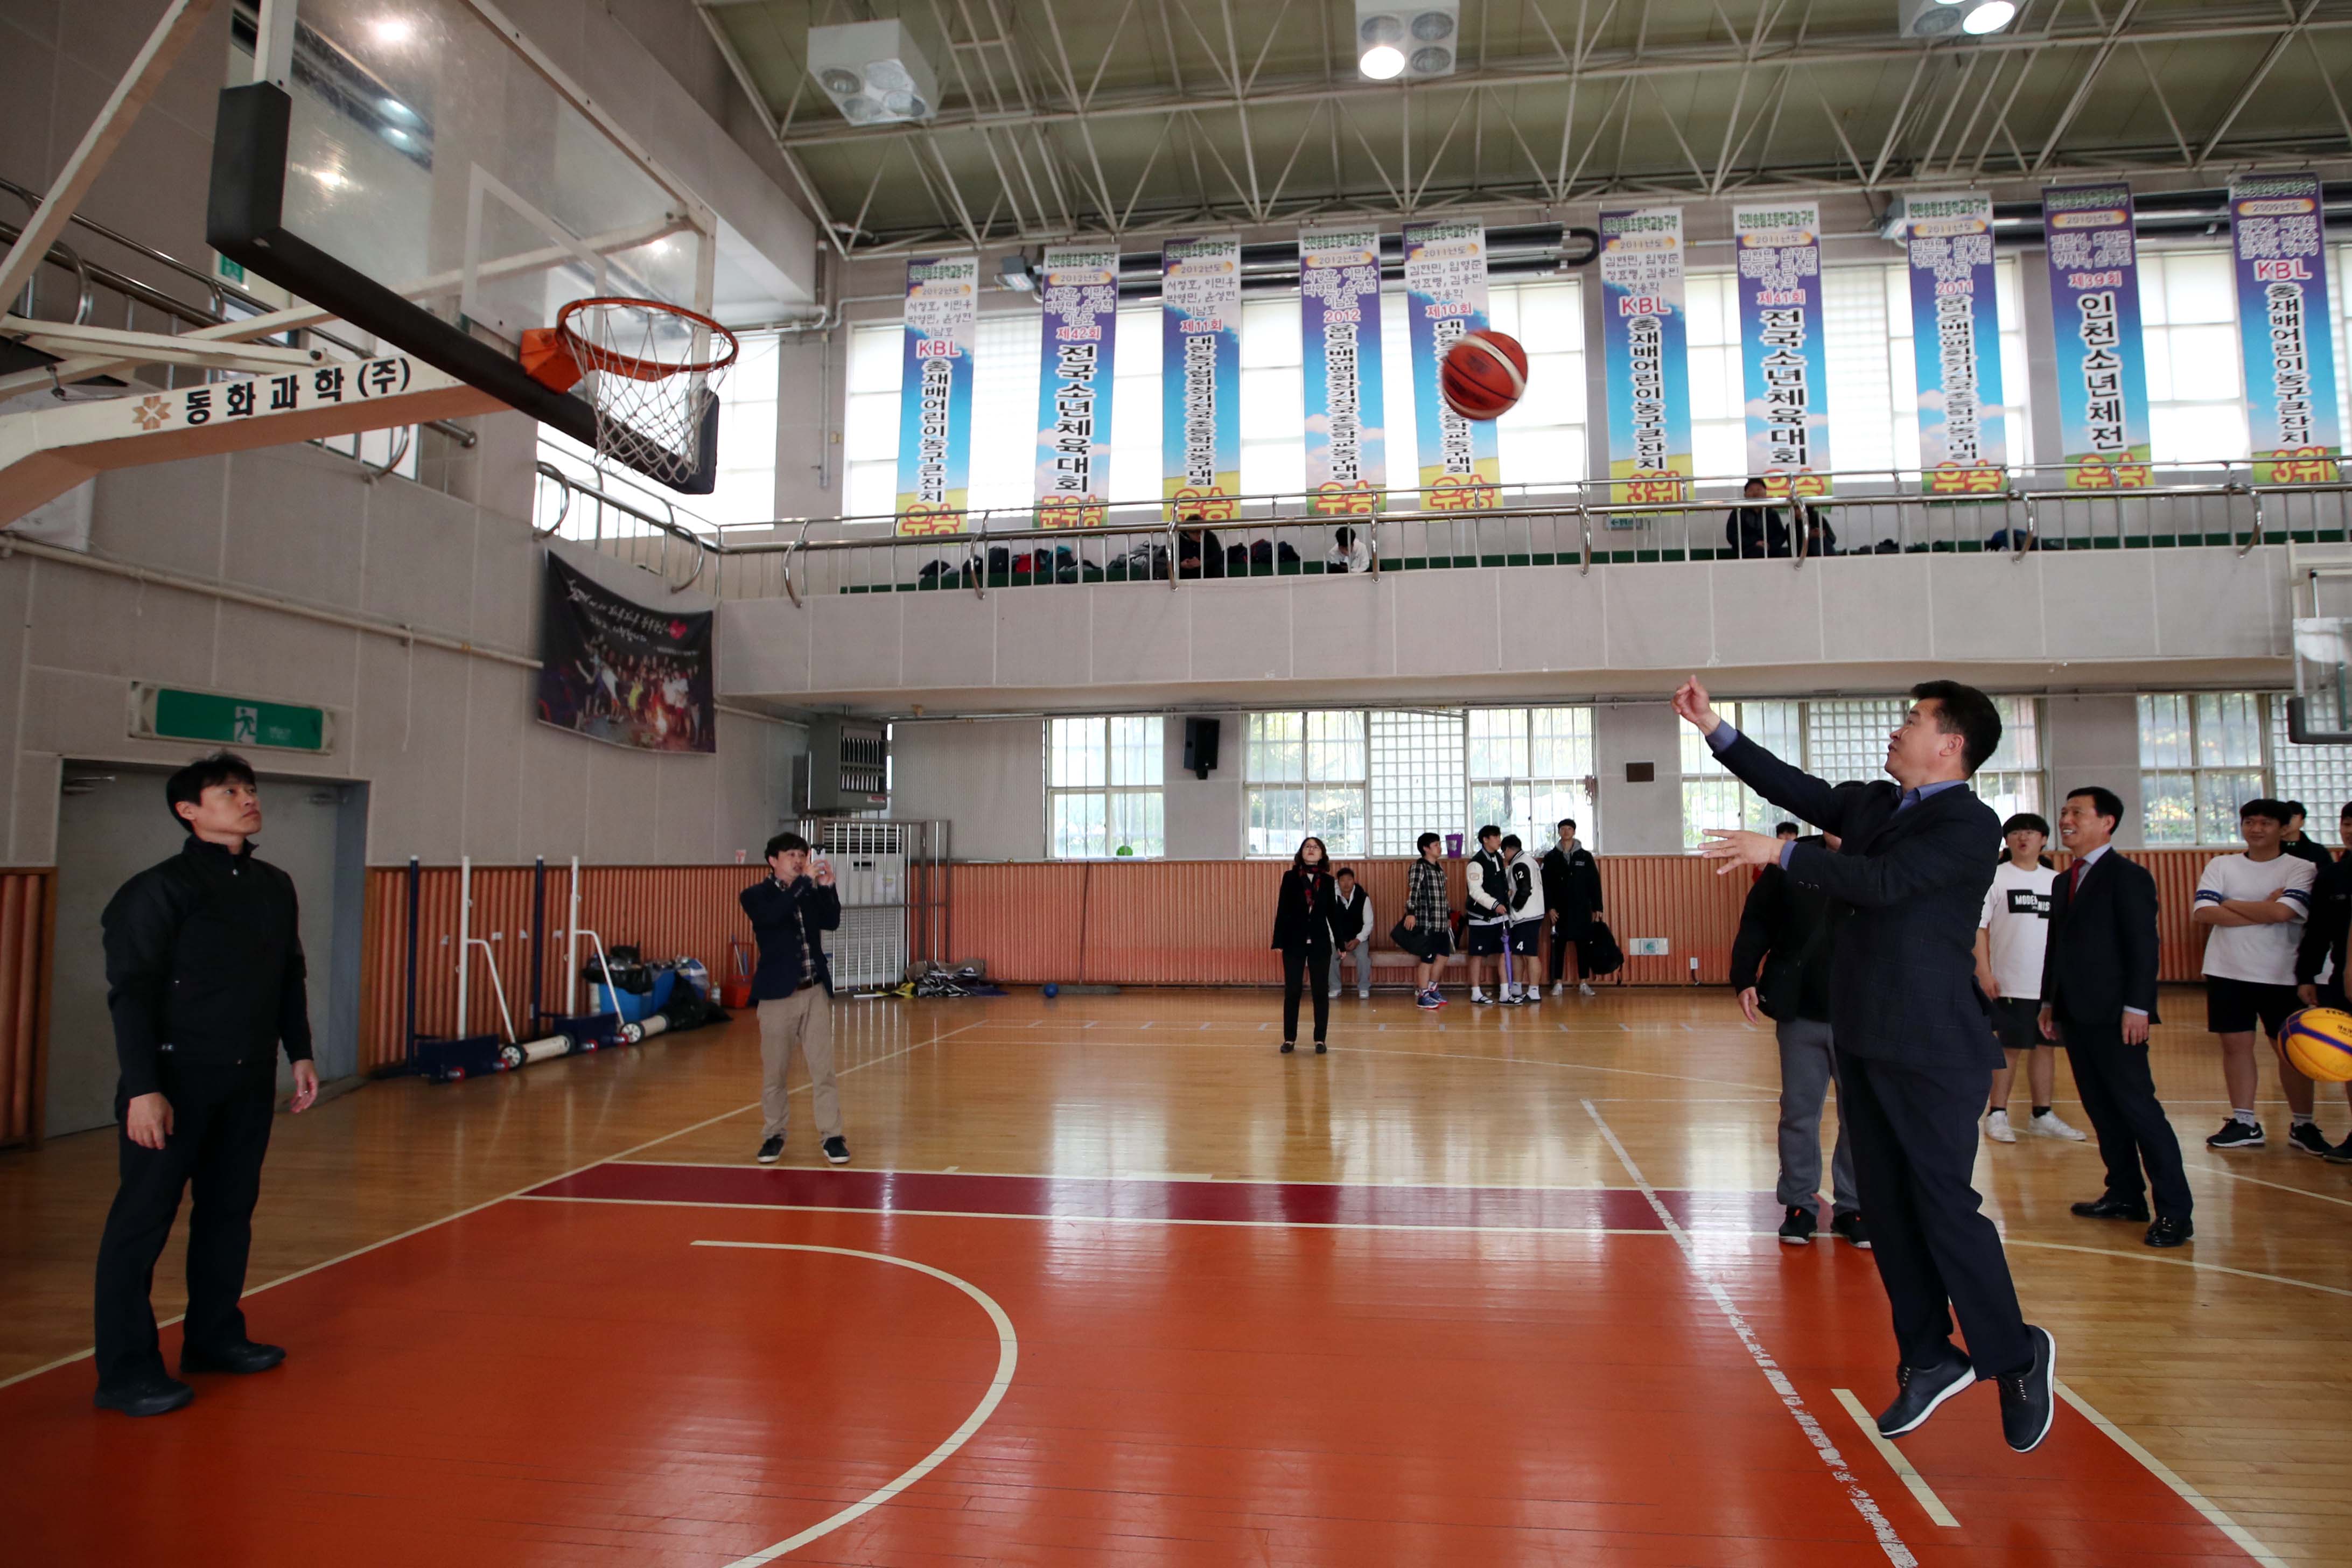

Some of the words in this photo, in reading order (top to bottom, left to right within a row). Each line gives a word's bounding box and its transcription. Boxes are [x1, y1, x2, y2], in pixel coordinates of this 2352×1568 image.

[1319, 254, 1362, 264] 2012년도
[1424, 246, 1466, 257] 2011년도
[1181, 263, 1222, 274] 2012년도
[1343, 267, 1377, 280] 이민우
[2257, 260, 2309, 279] KBL
[1205, 277, 1236, 289] 이민우
[2071, 271, 2122, 289] 제39회
[1304, 283, 1341, 297] 박영민,
[1937, 281, 1973, 295] 2011
[1167, 292, 1201, 304] 박영민,
[1324, 296, 1358, 309] 이남호
[1758, 290, 1805, 304] 제41회
[1427, 302, 1472, 318] 제10회
[1622, 296, 1670, 314] KBL
[1325, 309, 1360, 323] 2012
[1182, 319, 1222, 332] 제11회
[1058, 327, 1100, 340] 제42회
[918, 340, 960, 356] KBL
[2269, 284, 2310, 444] 총재배어린이농구큰잔치
[2081, 293, 2124, 451] 인천소년체전
[1631, 317, 1667, 471] 총재배어린이농구큰잔치
[1763, 310, 1807, 465] 전국소년체육대회
[1055, 346, 1095, 492] 전국소년체육대회
[920, 360, 949, 502] 총재배어린이농구큰잔치
[2076, 453, 2146, 488] 우승
[2272, 446, 2329, 484] 3위
[1315, 480, 1380, 515] 우승
[1516, 941, 1524, 951] 4
